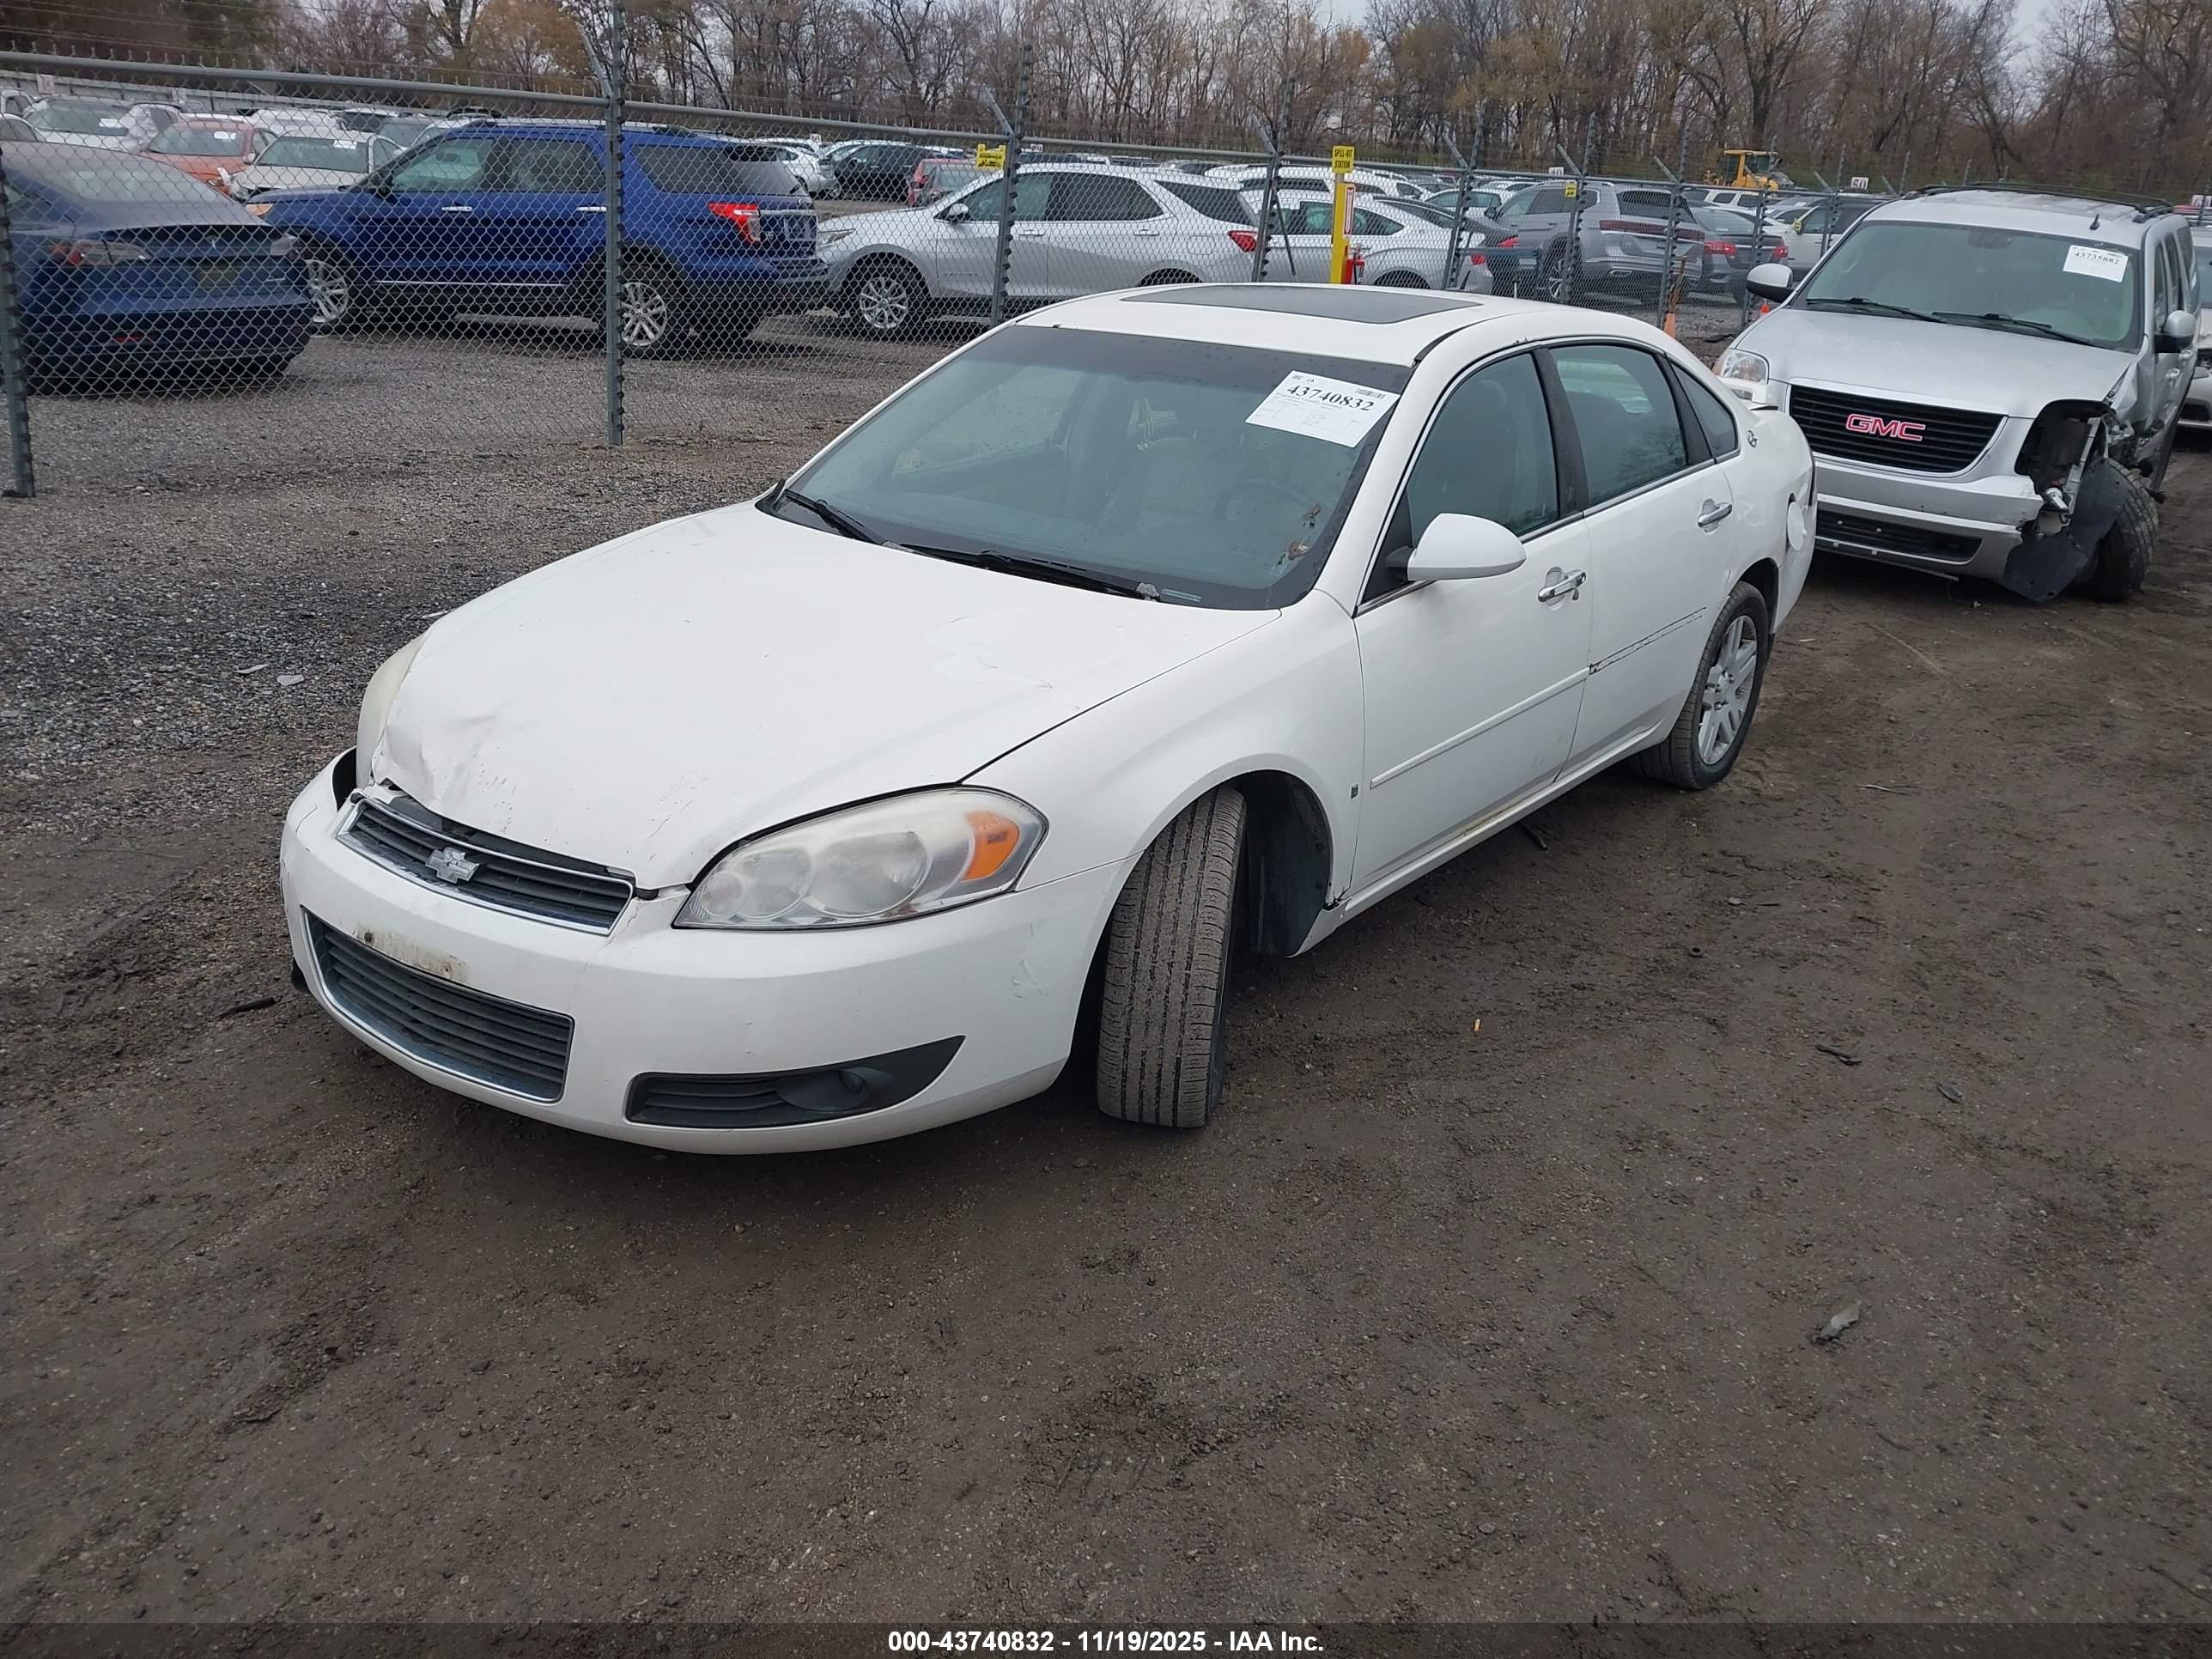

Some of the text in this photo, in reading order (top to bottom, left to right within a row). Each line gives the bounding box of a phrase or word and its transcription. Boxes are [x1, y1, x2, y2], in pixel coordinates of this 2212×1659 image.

[1852, 179, 1867, 189] 50
[1287, 385, 1375, 410] 43740832
[1845, 413, 1926, 441] GMC
